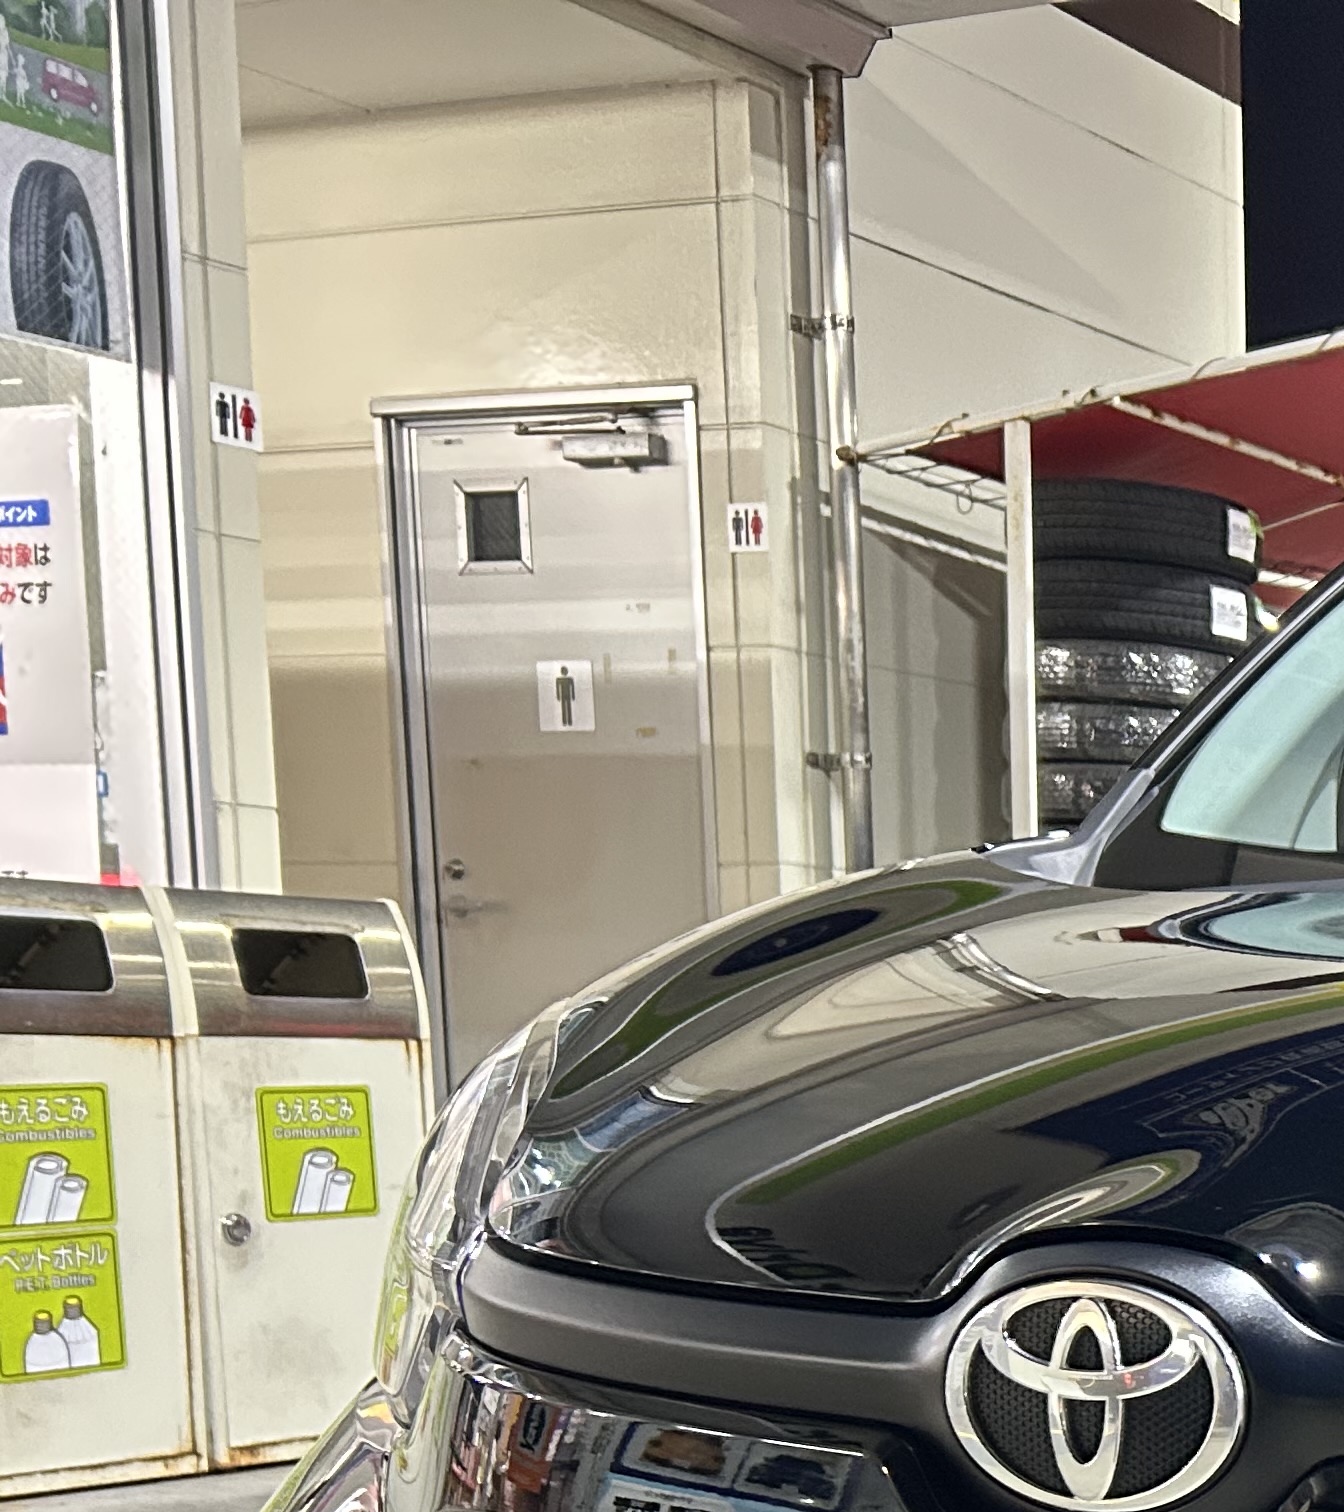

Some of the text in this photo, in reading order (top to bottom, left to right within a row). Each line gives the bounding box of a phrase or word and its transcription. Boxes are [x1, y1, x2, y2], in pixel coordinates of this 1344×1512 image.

[0, 1097, 88, 1125] もえるごみ
[276, 1096, 355, 1123] もえるごみ
[273, 1126, 361, 1139] Combustibles
[0, 1242, 108, 1271] ペットボトル
